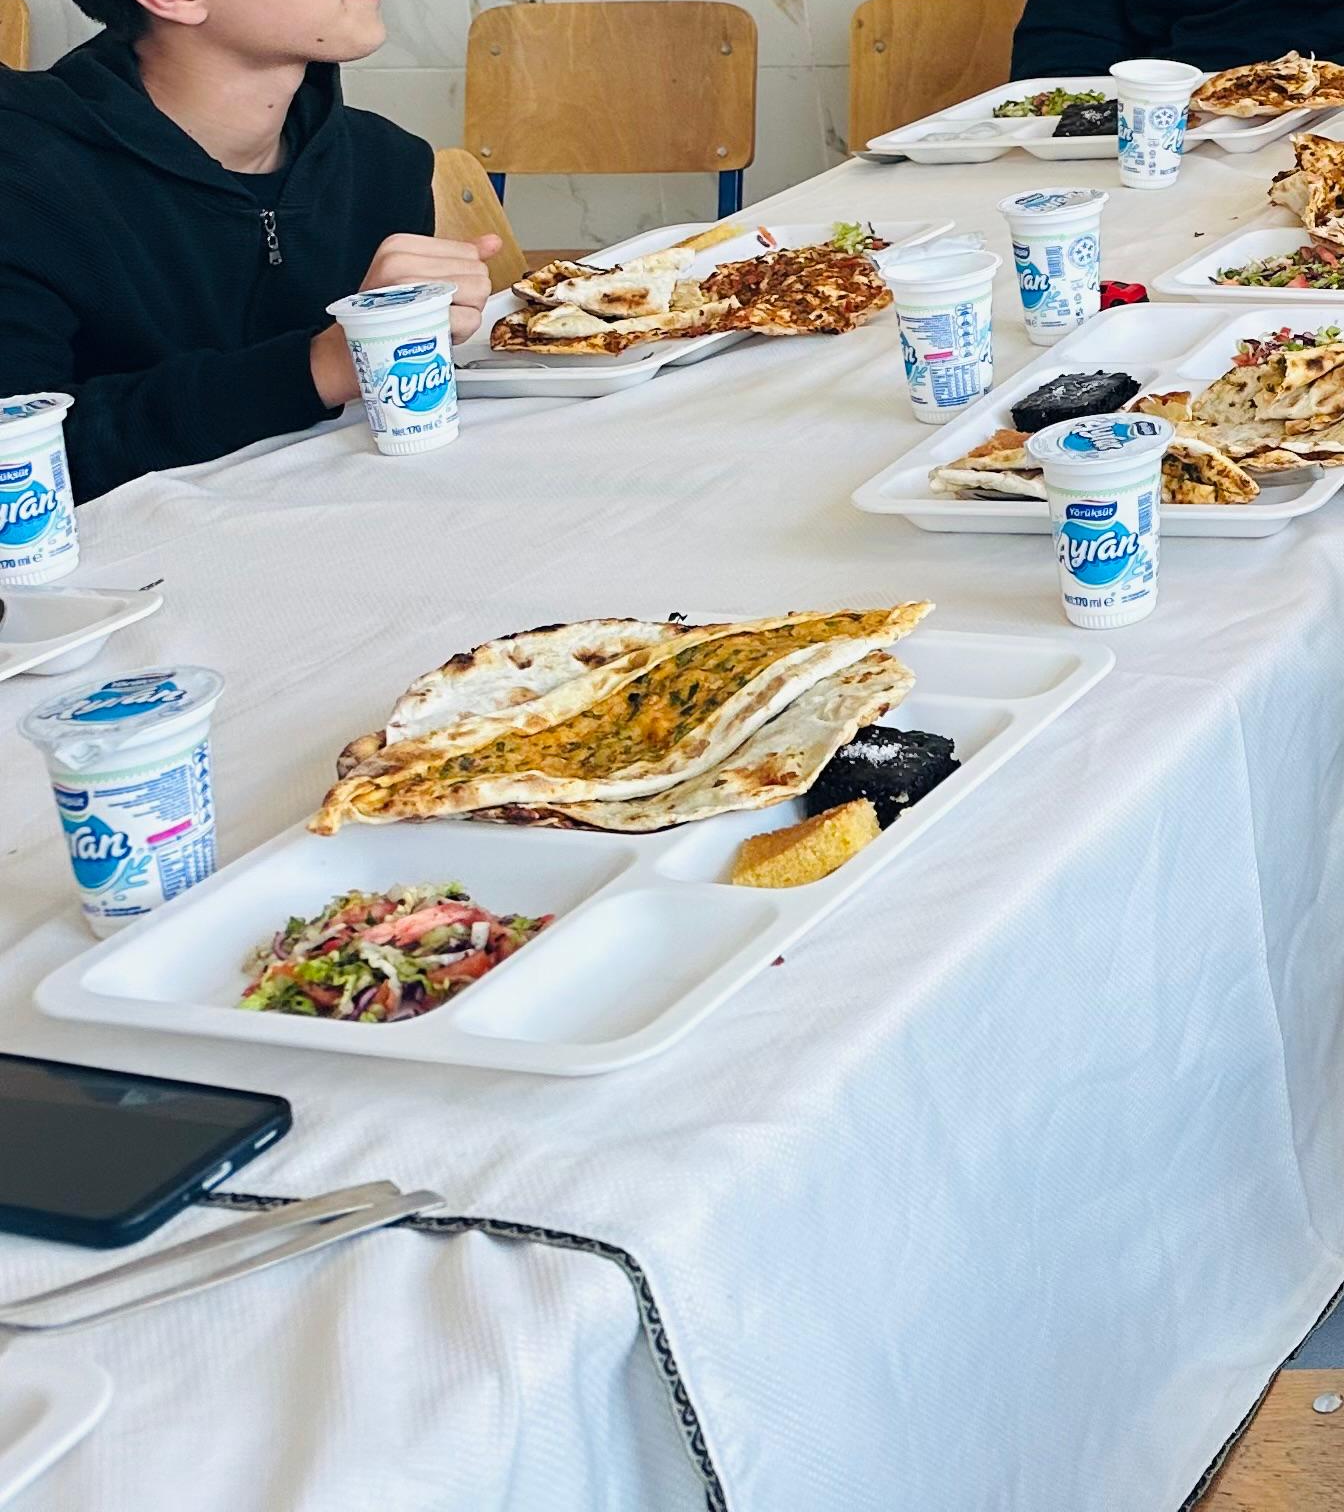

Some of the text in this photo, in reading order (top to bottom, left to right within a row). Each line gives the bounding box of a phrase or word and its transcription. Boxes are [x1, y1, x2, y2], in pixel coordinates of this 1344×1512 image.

[1020, 269, 1050, 292] ran
[379, 362, 454, 409] Ayran
[1069, 506, 1114, 519] Yörüksüt
[1057, 532, 1139, 575] Ayran
[69, 826, 132, 860] ran
